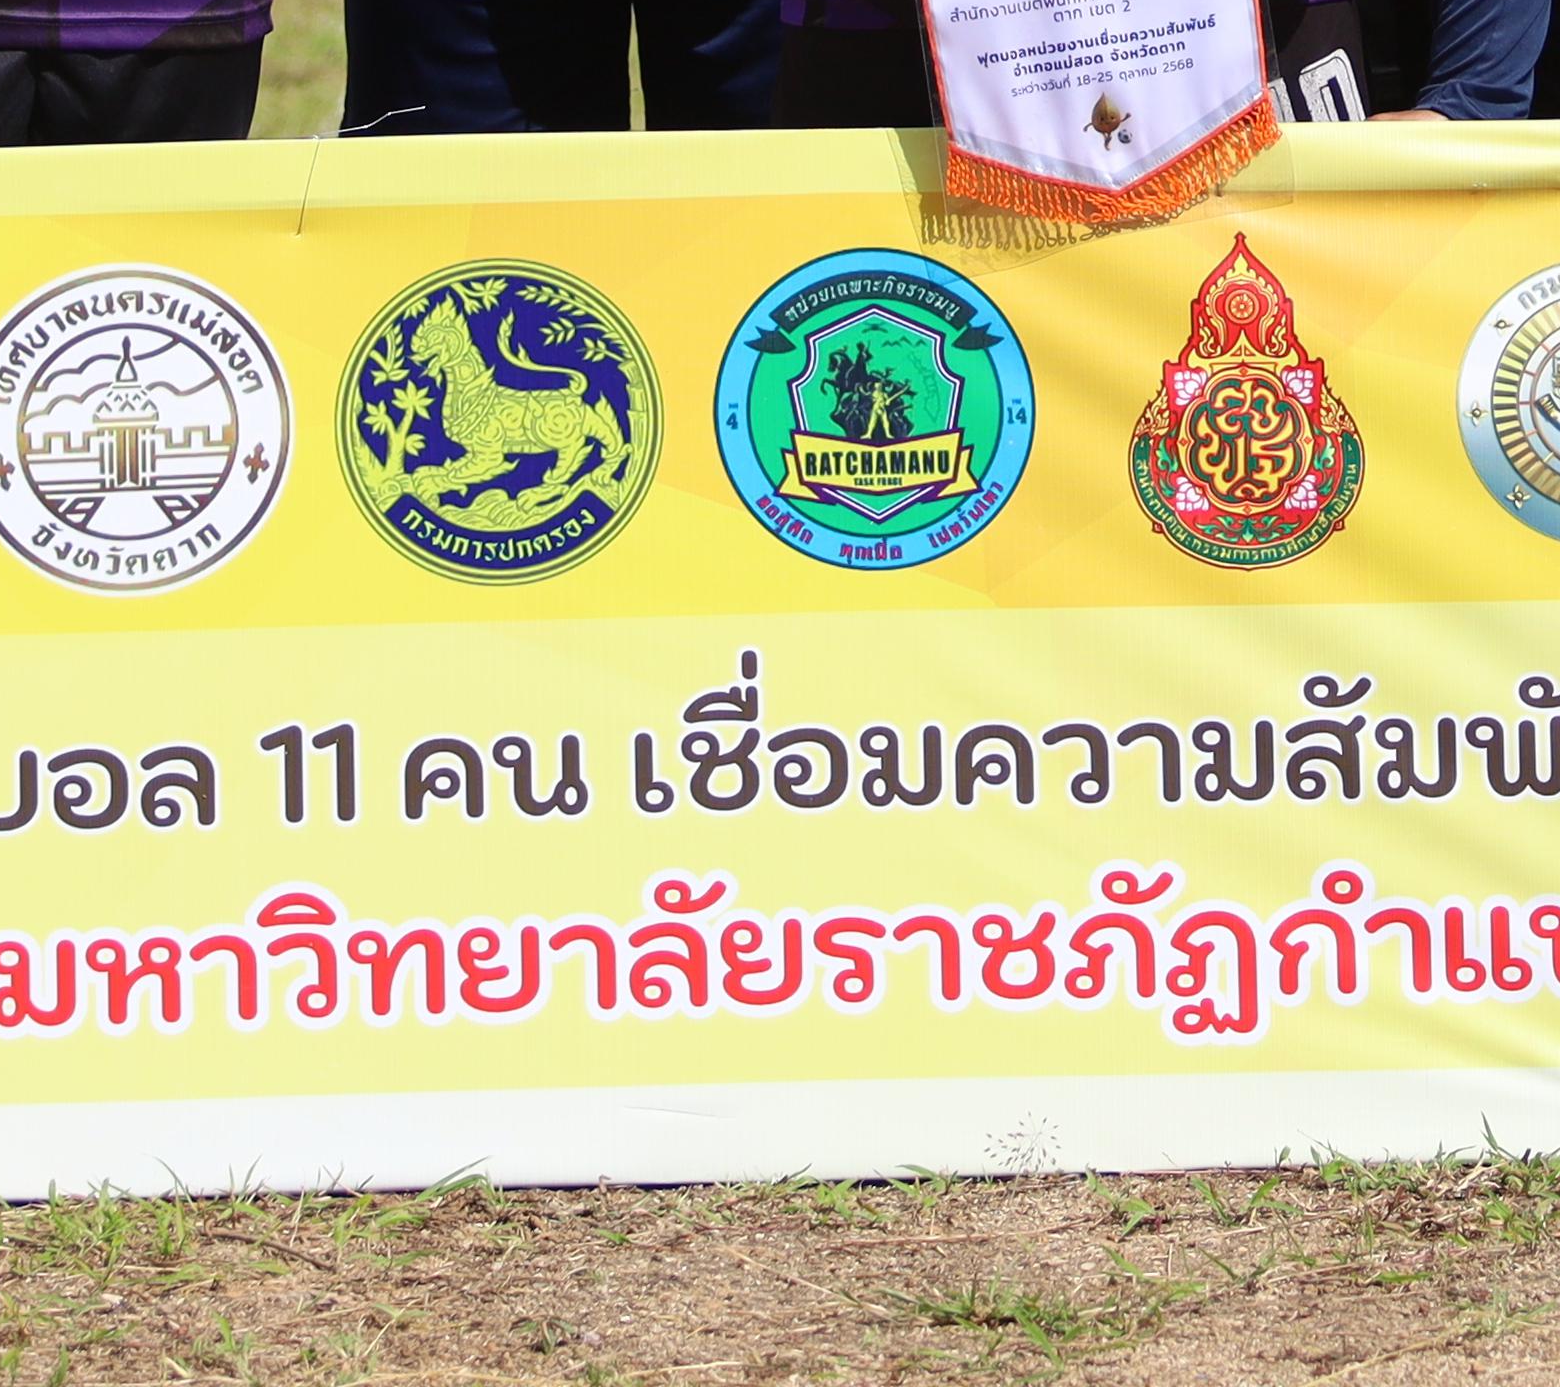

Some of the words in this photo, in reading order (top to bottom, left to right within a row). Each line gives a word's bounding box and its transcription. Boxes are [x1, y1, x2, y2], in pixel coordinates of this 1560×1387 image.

[1053, 8, 1083, 23] ตาก
[1089, 3, 1116, 18] เขต
[1123, 0, 1131, 13] 2
[1013, 52, 1104, 77] อำเภอแม่สอด
[1110, 39, 1186, 62] จังหวัดตาก
[1011, 73, 1072, 97] ระหว่างวันที่
[1077, 69, 1114, 87] 18-25
[1119, 65, 1158, 82] ตุลาคม
[1162, 58, 1194, 74] 2568
[726, 412, 738, 430] 4
[1007, 407, 1027, 424] 14
[805, 450, 950, 476] RATCHAMANU
[854, 478, 874, 486] TASK
[31, 521, 222, 576] จังหวัดตาก
[402, 509, 596, 562] กรมการปกครอง
[259, 723, 355, 823] 11
[403, 734, 588, 820] คน
